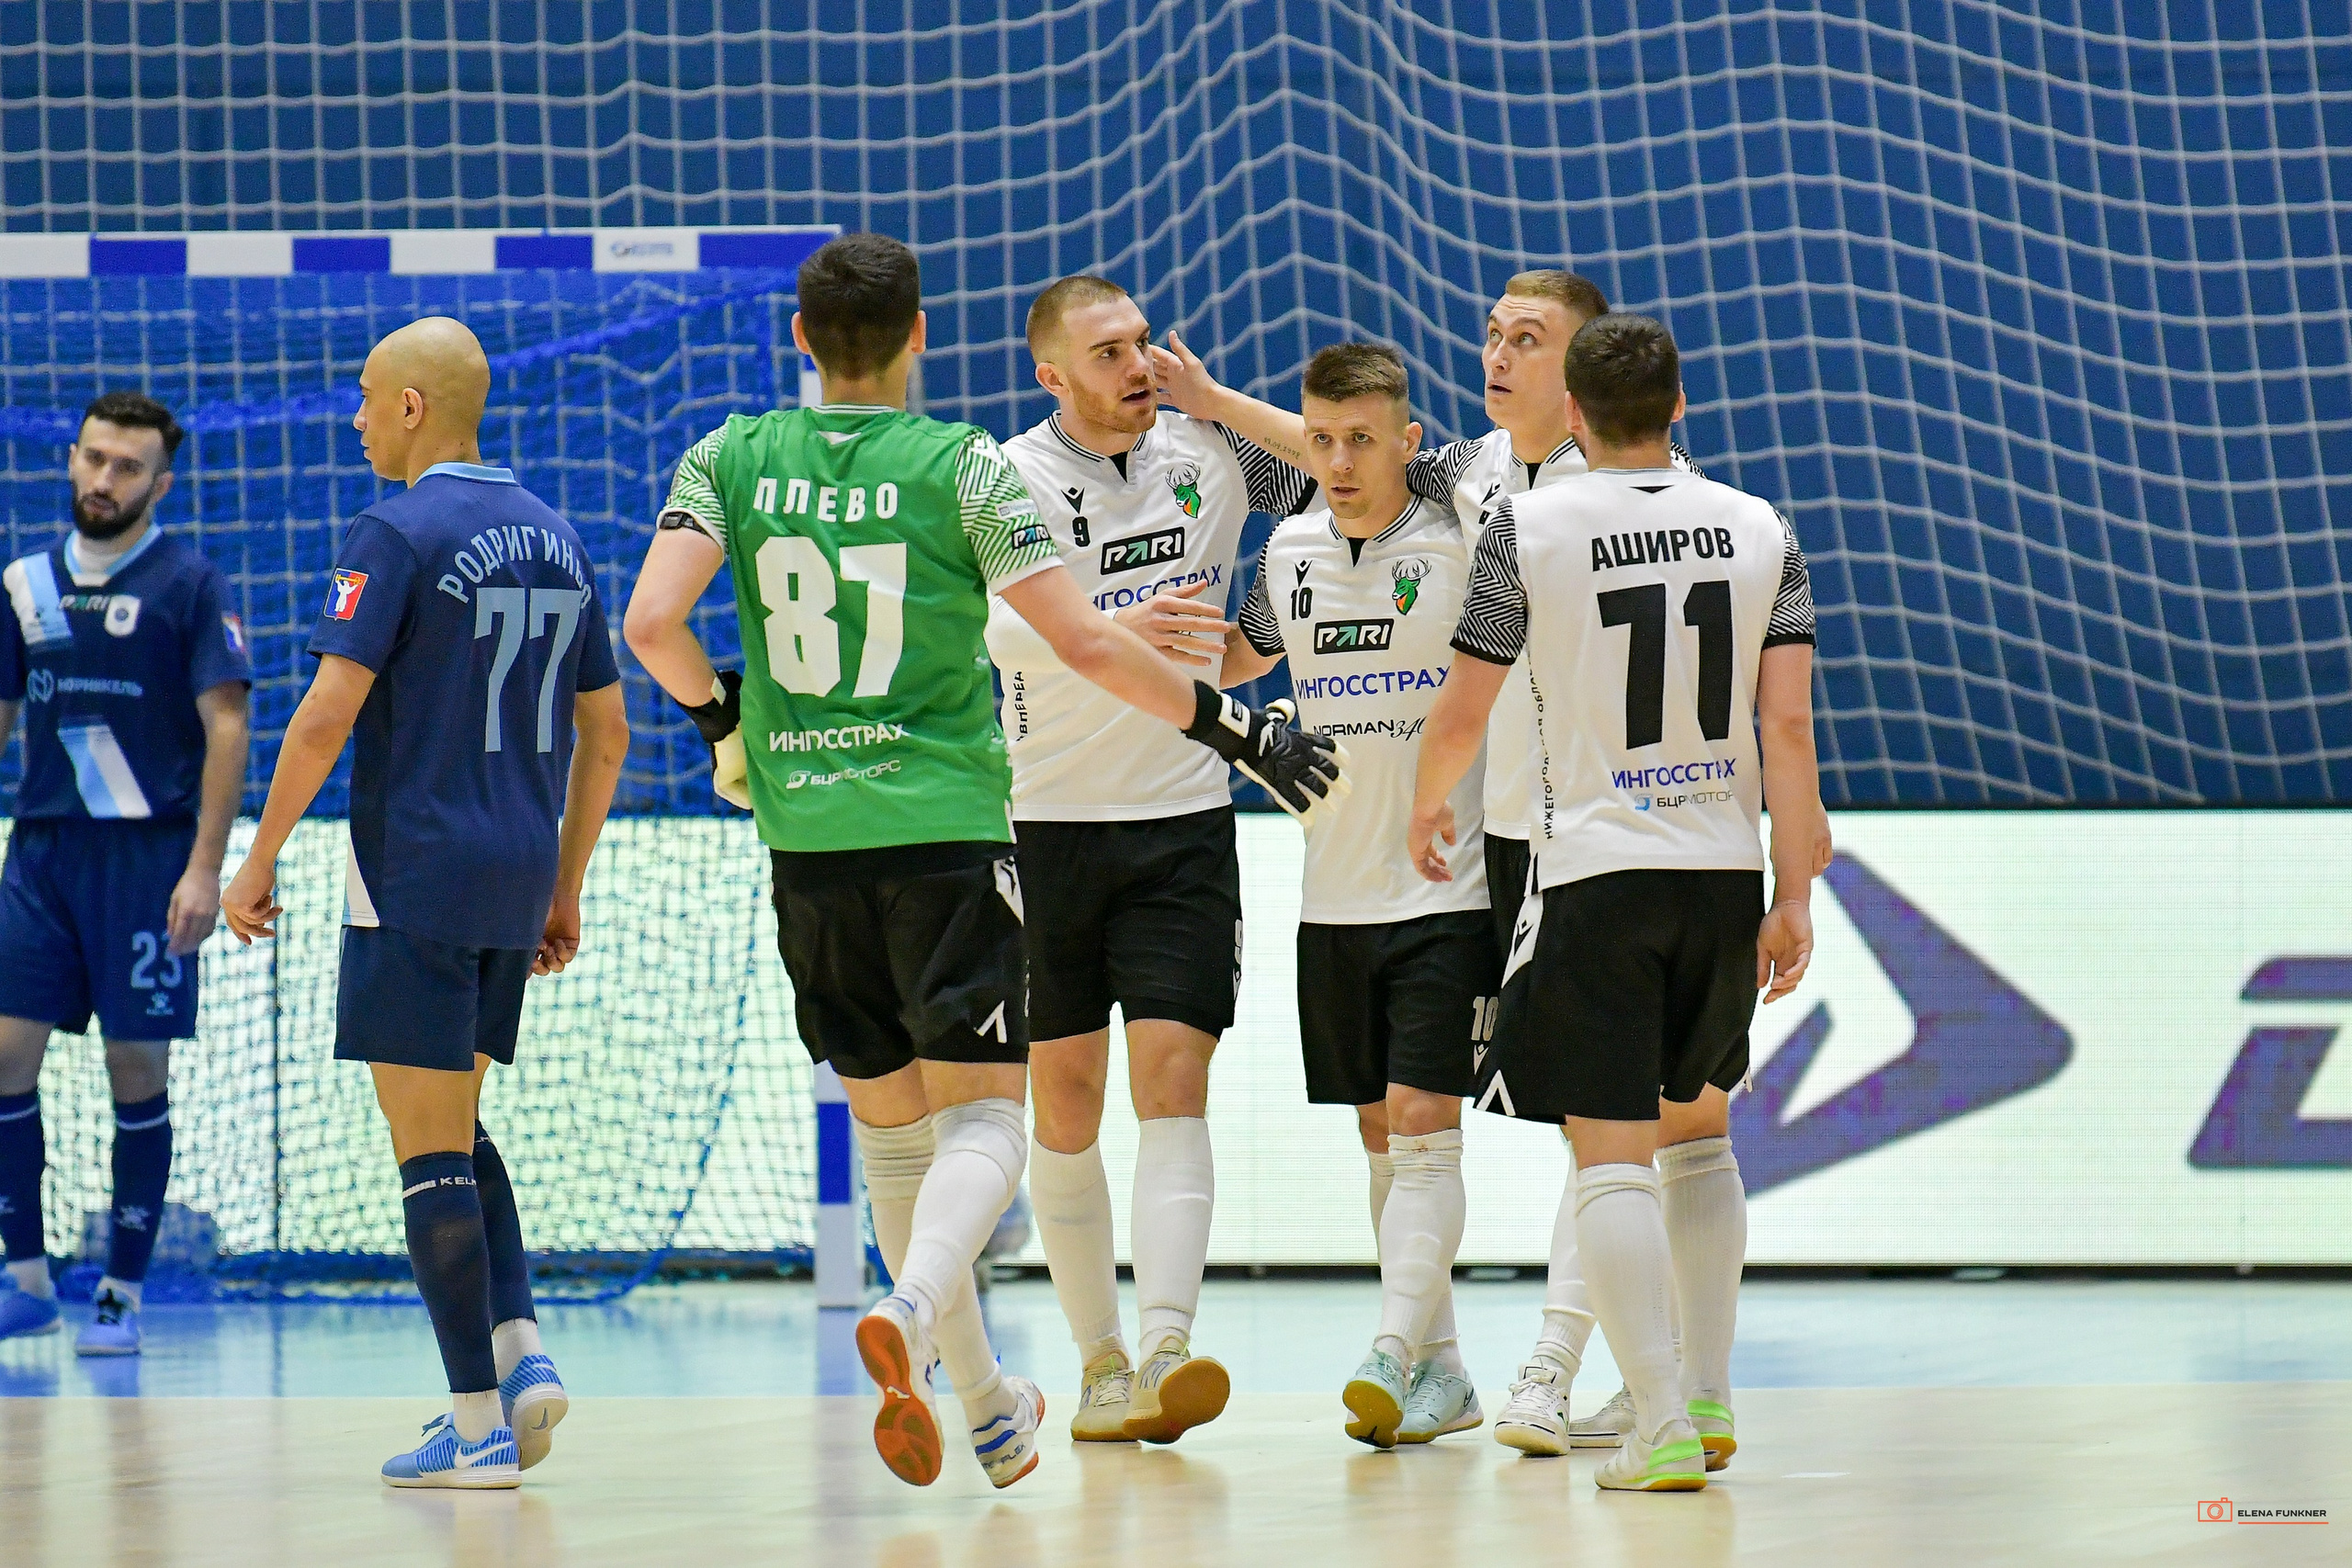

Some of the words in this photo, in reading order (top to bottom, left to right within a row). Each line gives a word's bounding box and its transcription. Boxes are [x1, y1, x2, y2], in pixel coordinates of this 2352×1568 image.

[752, 476, 899, 523] ПЛЕВО
[1072, 516, 1091, 547] 9
[1103, 533, 1182, 570] PARI
[1591, 527, 1735, 571] АШИРОВ
[436, 525, 593, 609] РОДРИГИНЬО
[755, 536, 907, 698] 87
[1290, 587, 1313, 620] 10
[1317, 624, 1390, 649] PARI
[474, 587, 582, 753] 77
[1295, 665, 1451, 700] ИНГОССТРАХ
[1597, 580, 1734, 750] 71
[809, 760, 901, 786] БЦРОТОРС
[1611, 758, 1736, 789] ИНГОССТХ
[130, 931, 182, 988] 23
[1471, 996, 1498, 1041] 10
